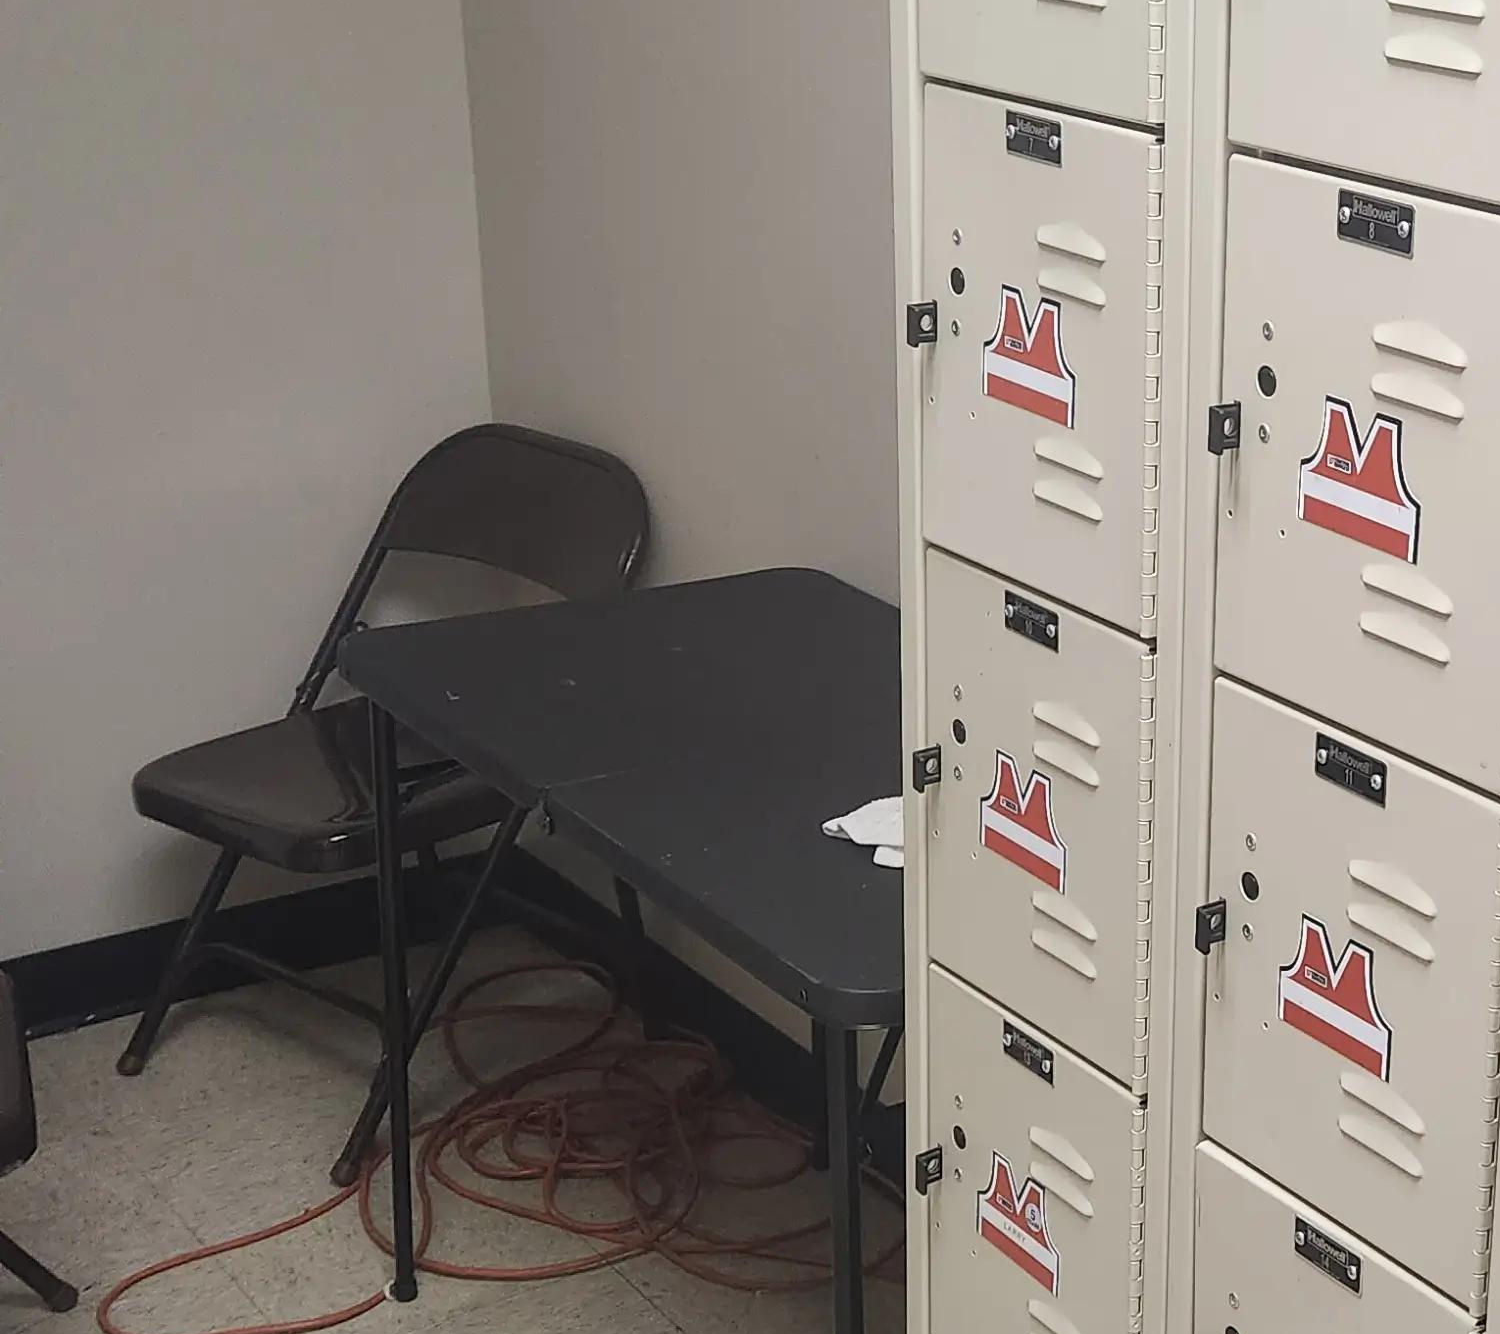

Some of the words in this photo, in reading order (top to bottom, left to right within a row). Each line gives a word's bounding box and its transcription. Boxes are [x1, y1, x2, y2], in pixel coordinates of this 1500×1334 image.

[1016, 119, 1049, 138] Hallowell
[1028, 137, 1034, 153] 7
[1353, 202, 1397, 223] Hallowell
[1368, 222, 1375, 240] 8
[1015, 602, 1046, 625] Hallowell
[1329, 747, 1370, 775] Hallowell
[1344, 768, 1354, 786] 11
[1013, 1033, 1044, 1060] Hallowell
[1030, 1209, 1036, 1221] 5
[1307, 1228, 1346, 1263] Hallowell
[1320, 1253, 1330, 1271] 14
